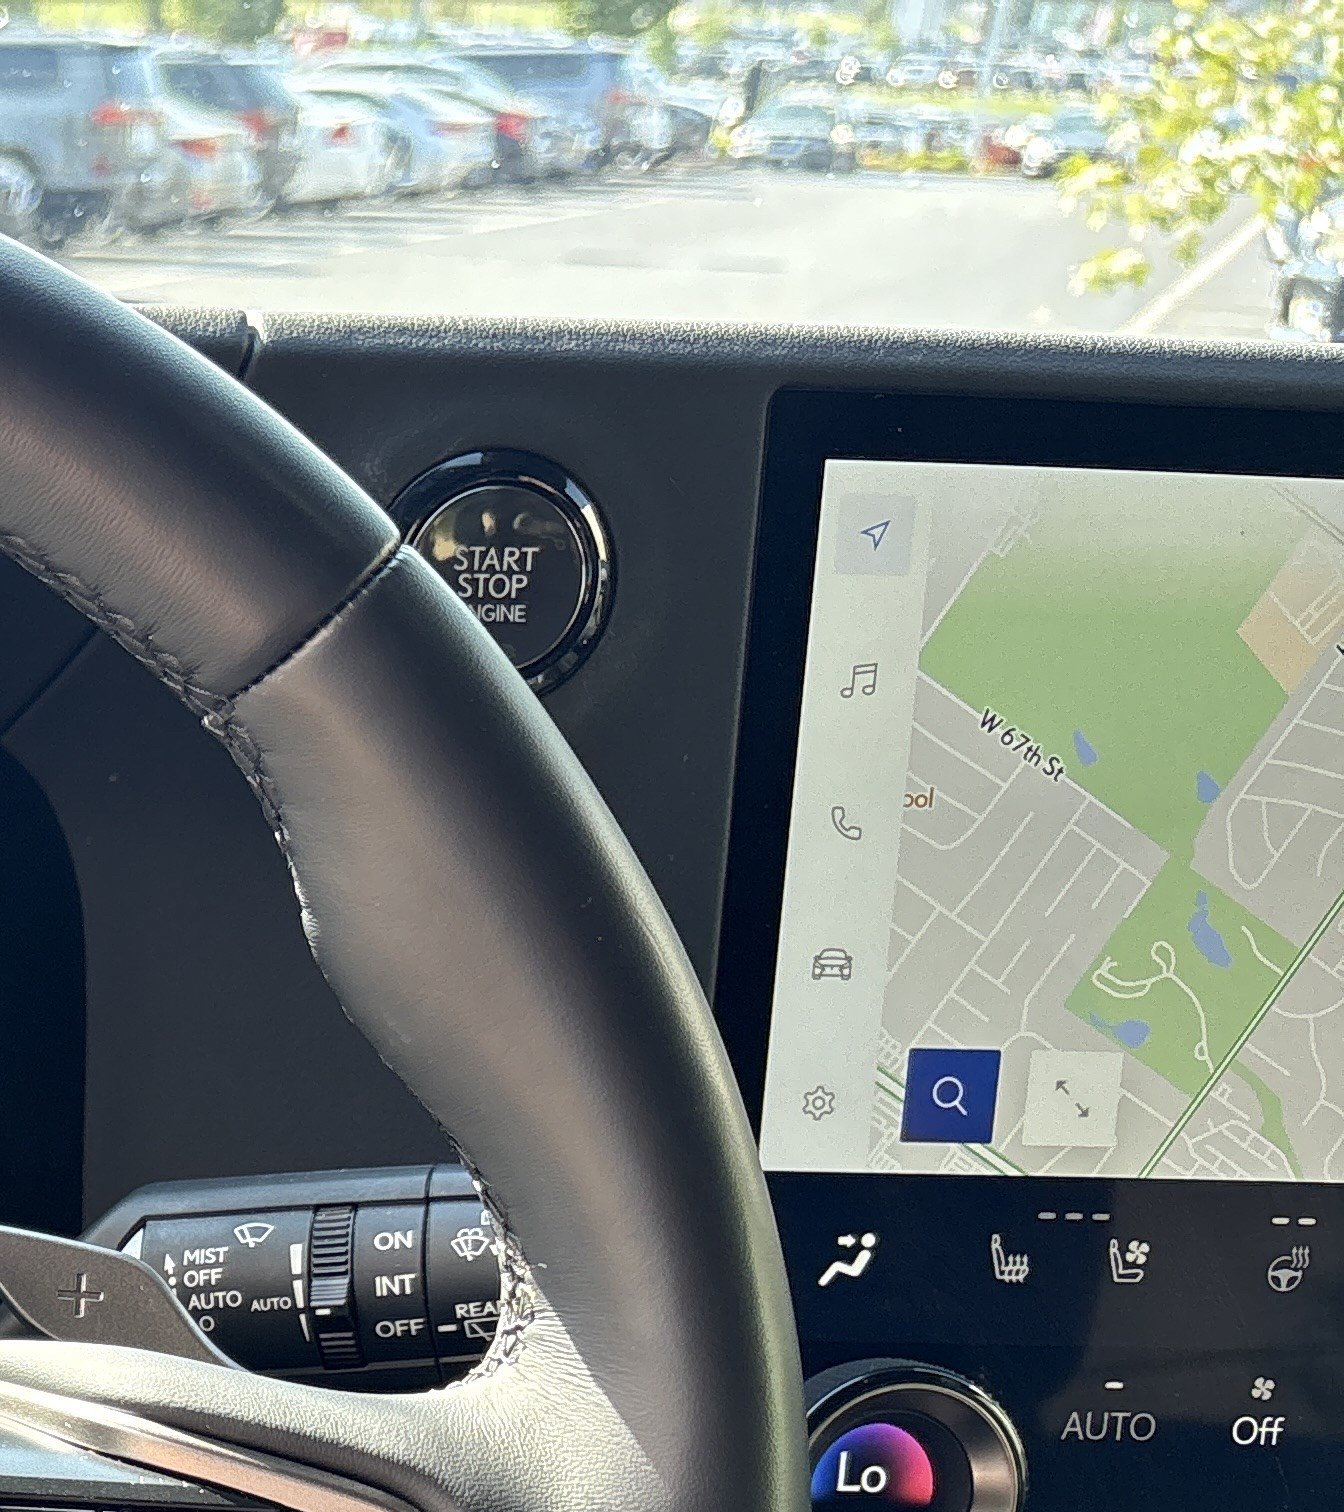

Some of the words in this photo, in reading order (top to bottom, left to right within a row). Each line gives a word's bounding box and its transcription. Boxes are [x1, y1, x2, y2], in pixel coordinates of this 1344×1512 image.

[453, 546, 540, 572] START
[457, 572, 529, 599] STOP
[470, 603, 527, 623] NGINE
[980, 707, 1004, 734] W
[1000, 726, 1043, 768] 67th
[1041, 756, 1065, 783] St
[373, 1229, 414, 1251] ON
[182, 1246, 230, 1267] MIST
[183, 1267, 225, 1288] OFF
[374, 1272, 417, 1298] INT
[188, 1290, 243, 1311] AUTO
[250, 1296, 293, 1313] AUTO
[374, 1317, 427, 1339] OFF
[1060, 1411, 1158, 1443] AUTO
[1230, 1415, 1286, 1447] Off
[835, 1451, 888, 1494] Lo
